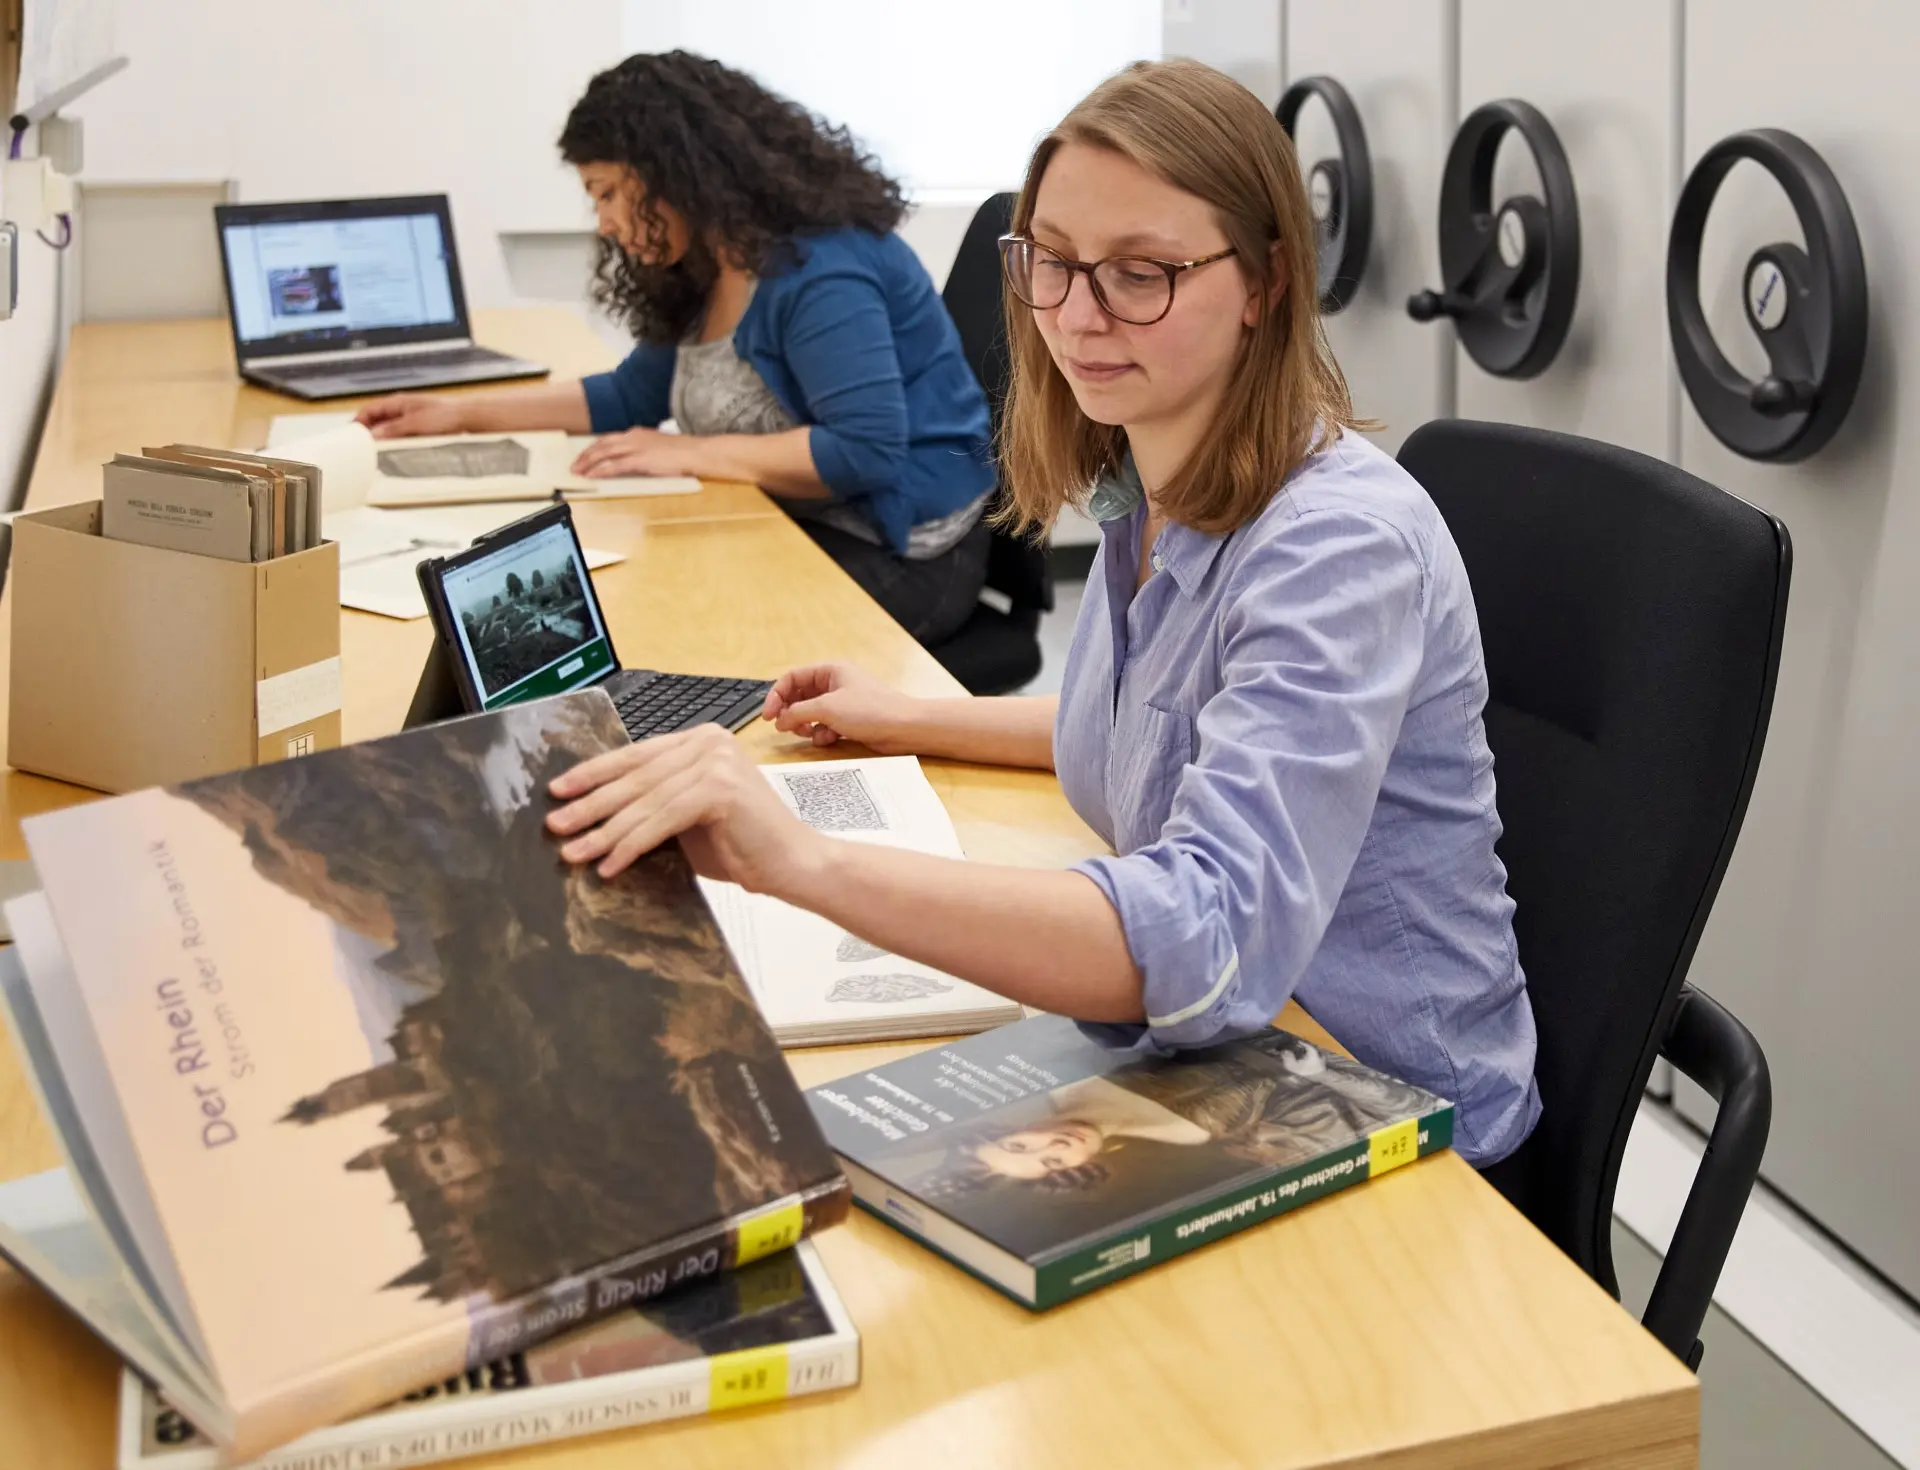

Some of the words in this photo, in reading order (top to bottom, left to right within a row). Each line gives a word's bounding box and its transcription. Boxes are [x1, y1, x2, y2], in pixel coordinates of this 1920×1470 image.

[149, 839, 205, 950] Romantik
[193, 956, 224, 996] der
[156, 977, 211, 1075] Rhein
[213, 1001, 256, 1079] Strom
[192, 1082, 239, 1150] Der
[1278, 1179, 1300, 1198] des
[1301, 1157, 1356, 1188] Gesichter
[1176, 1197, 1257, 1239] Jahrhunderts
[1260, 1191, 1278, 1208] 19.
[675, 1247, 719, 1278] Der
[597, 1268, 667, 1308] Rhein
